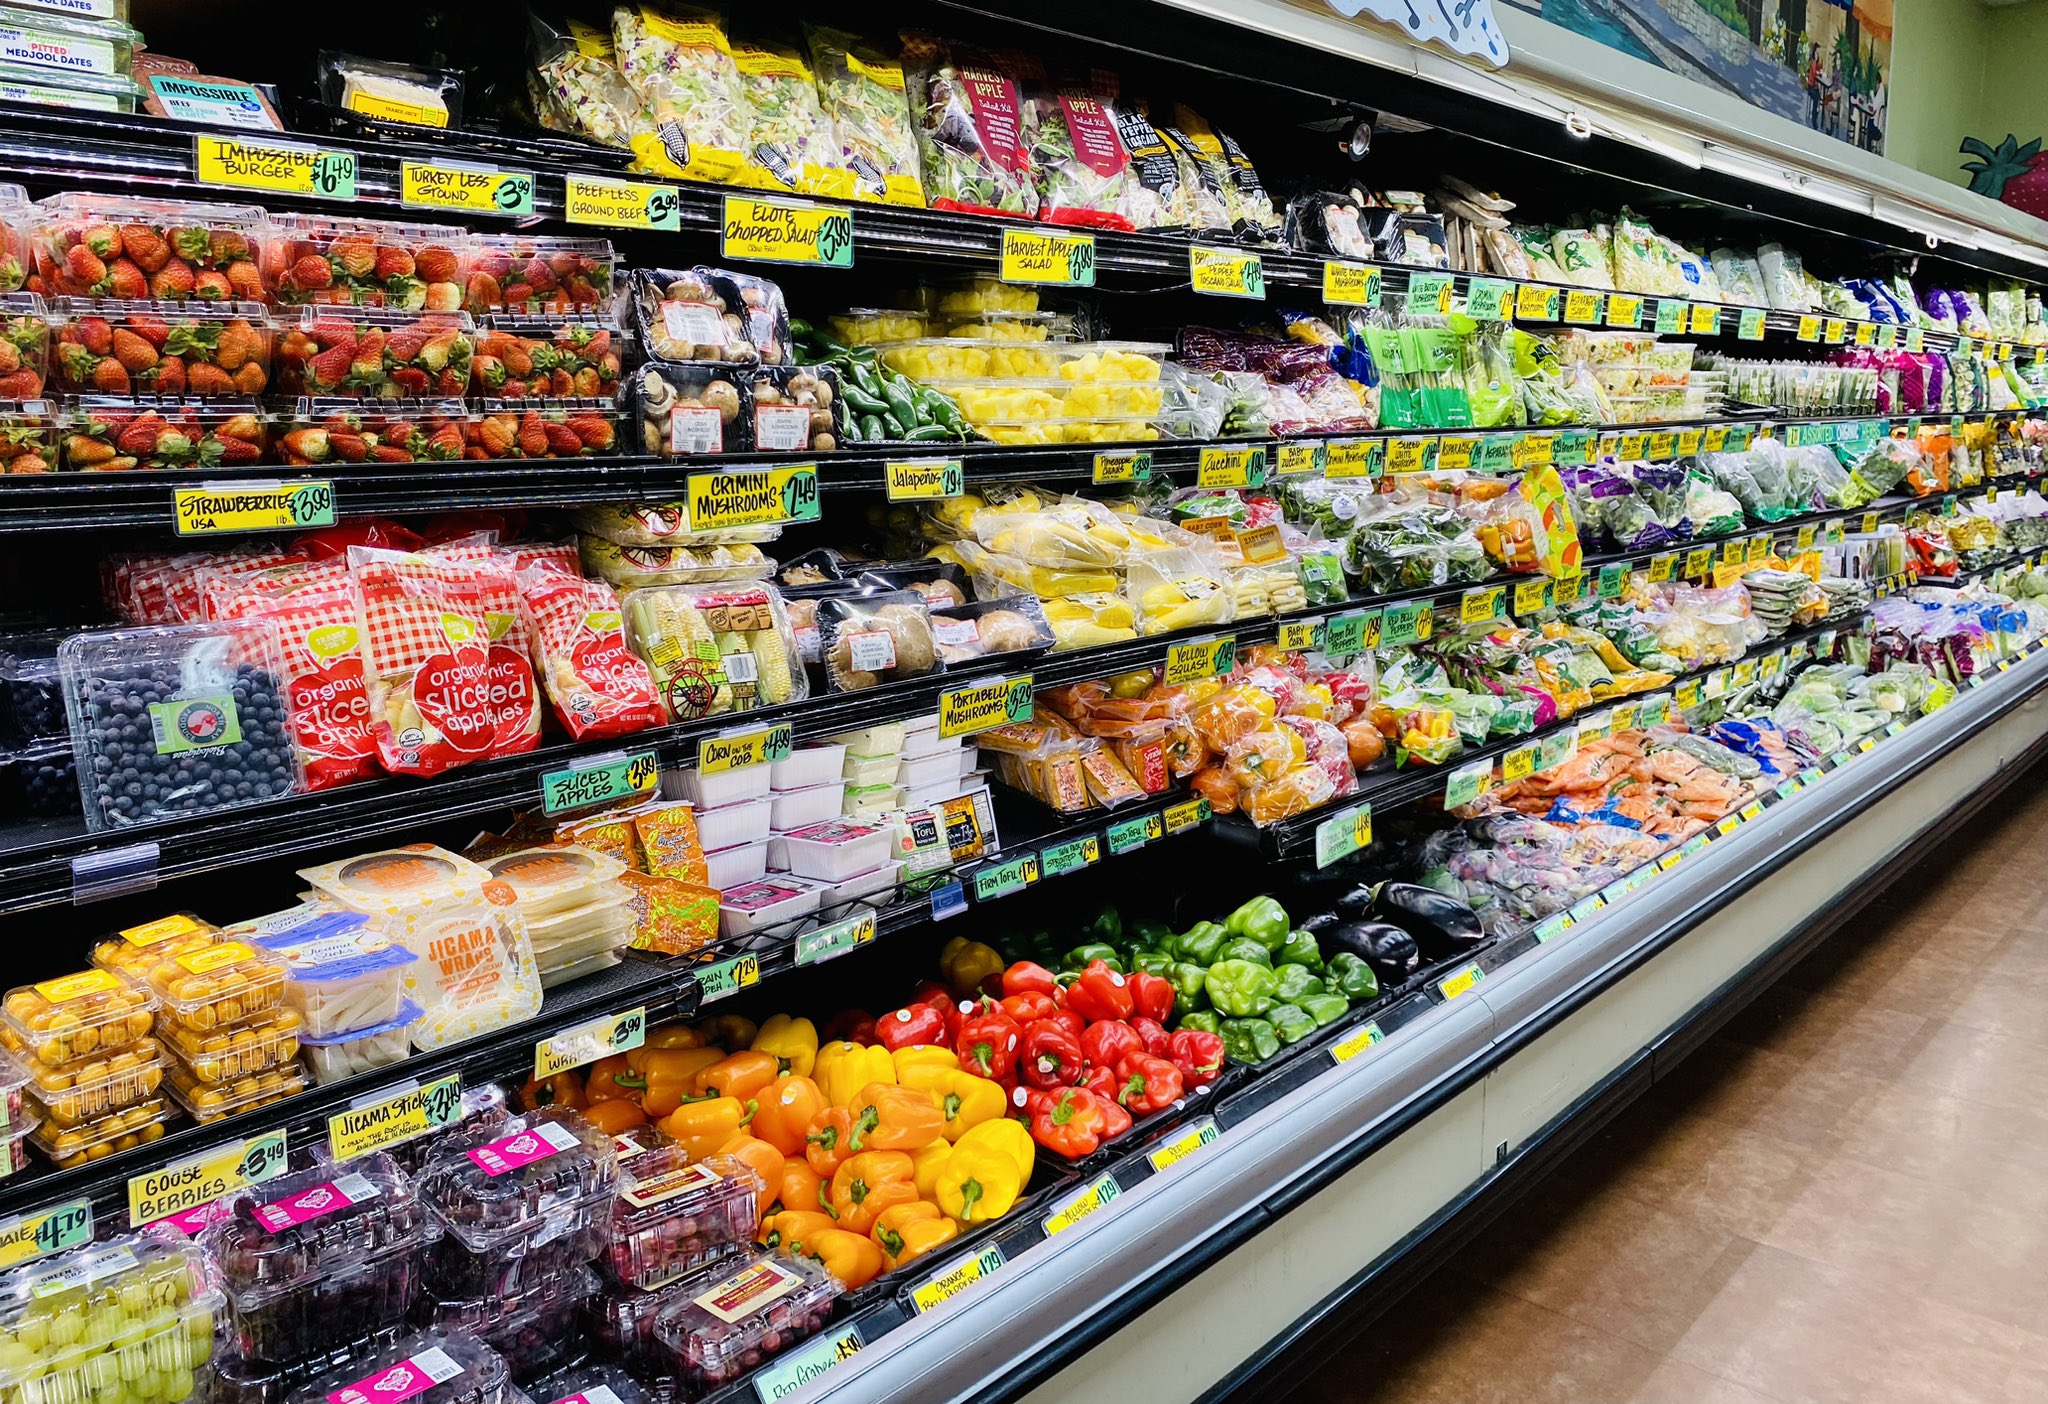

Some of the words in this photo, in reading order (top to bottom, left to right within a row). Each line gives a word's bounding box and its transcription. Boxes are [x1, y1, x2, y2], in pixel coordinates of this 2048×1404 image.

[6, 47, 58, 64] MEDJOOL
[60, 56, 93, 68] DATES
[31, 43, 67, 56] PITTED
[962, 65, 1005, 84] HARVEST
[160, 80, 250, 103] IMPOSSIBLE
[976, 84, 1005, 98] APPLE
[1069, 100, 1098, 114] APPLE
[213, 141, 322, 170] IMPOSSIBLE
[225, 161, 296, 179] BURGER
[407, 166, 454, 188] TURKEY
[460, 174, 490, 188] LESS
[417, 185, 469, 202] GROUND
[572, 202, 614, 218] GROUND
[617, 206, 643, 220] BEEF
[752, 203, 797, 223] ELOTE
[783, 221, 817, 246] SALAD
[1006, 238, 1046, 257] HARVEST
[1047, 242, 1073, 259] APPLE
[1018, 257, 1053, 271] SALAD
[710, 473, 769, 496] CRIMINI
[180, 492, 296, 517] STRAWBERRIES
[697, 486, 777, 520] MUSHROOMS
[191, 518, 217, 530] USA
[1287, 625, 1305, 637] BABY
[1288, 635, 1305, 648] CORN
[1169, 659, 1209, 677] SQUASH
[950, 684, 1010, 709] PORTABELLA
[297, 701, 369, 737] slice
[944, 700, 1003, 728] MUSHROOMS
[317, 720, 374, 750] apple
[706, 743, 731, 764] CORN
[730, 751, 752, 768] COB
[553, 769, 611, 791] SLICED
[555, 781, 614, 808] APPLES
[914, 826, 935, 838] TOFU
[1110, 832, 1128, 846] BAKED
[1126, 826, 1142, 839] TOFU
[997, 868, 1018, 883] TOFU
[429, 926, 497, 962] JICAMA
[699, 969, 723, 986] RAIN
[549, 1046, 594, 1071] WRAPS
[368, 1131, 383, 1141] THE
[146, 1166, 203, 1197] GOOSE
[140, 1178, 226, 1219] BERRIES
[935, 1267, 966, 1294] ORANGE
